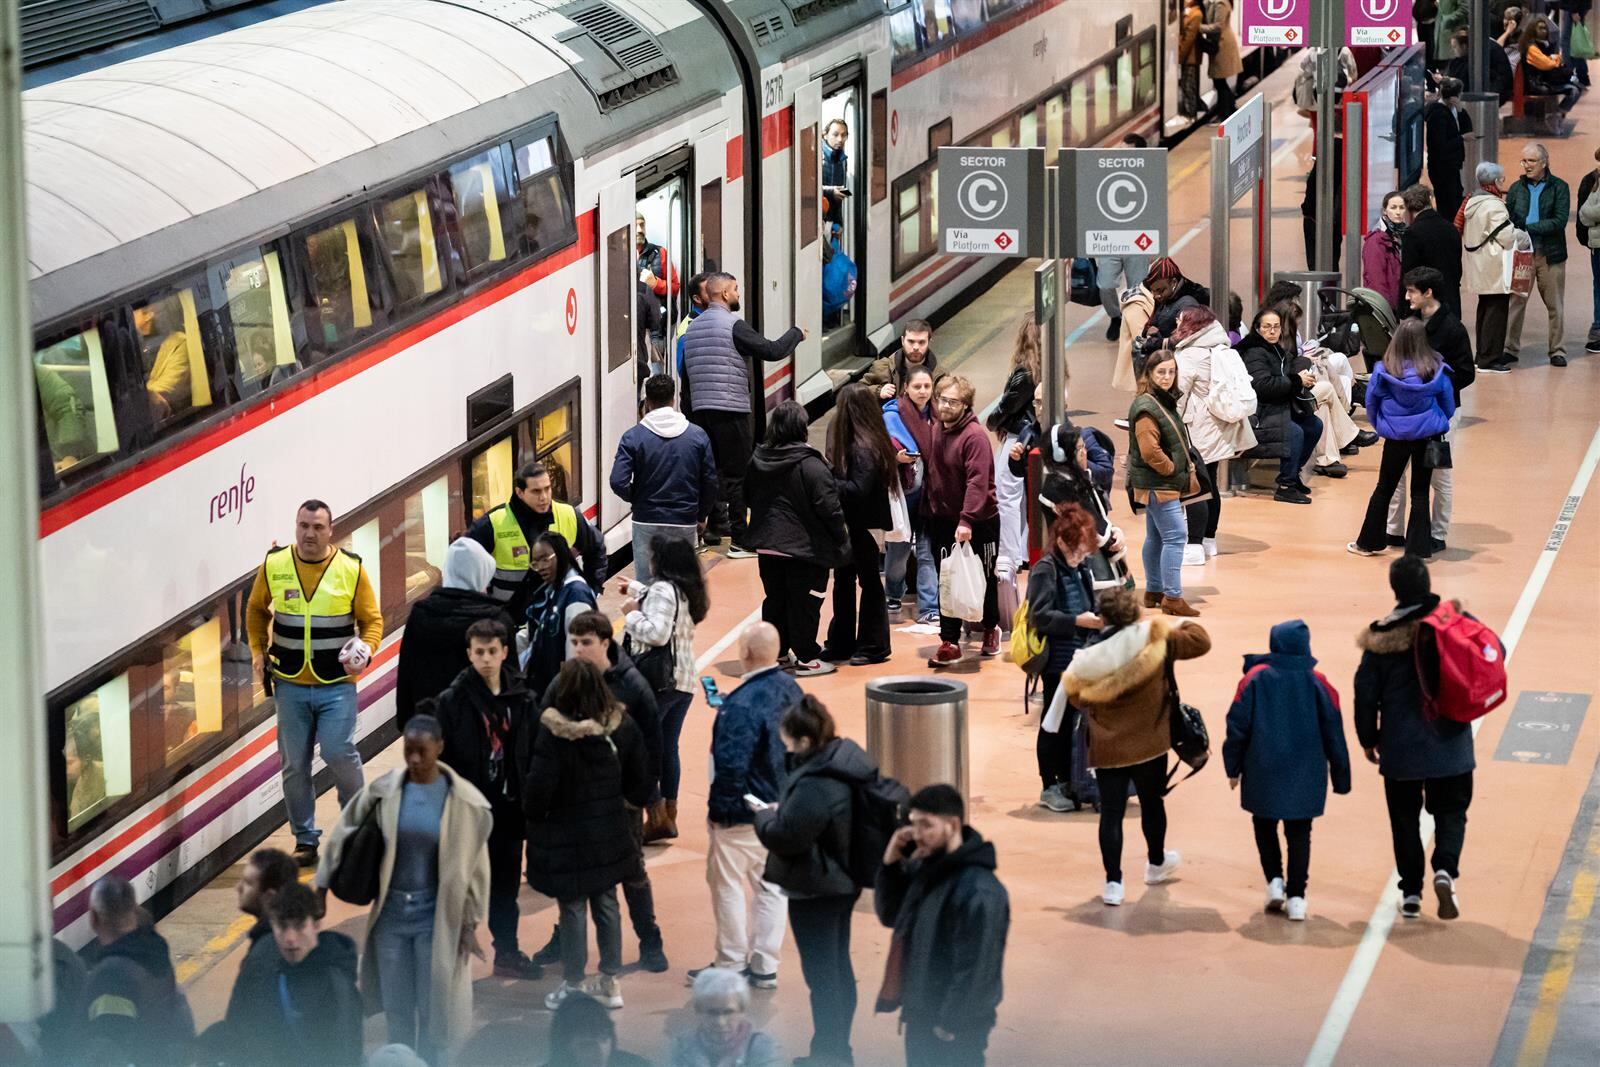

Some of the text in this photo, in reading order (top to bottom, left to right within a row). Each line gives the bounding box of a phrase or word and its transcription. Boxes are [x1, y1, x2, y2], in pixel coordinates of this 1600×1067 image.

[1253, 35, 1280, 43] Platform
[1288, 31, 1295, 39] 3
[1356, 36, 1384, 44] Platform
[1391, 32, 1398, 40] 4
[765, 74, 784, 108] 257R
[960, 156, 1006, 167] SECTOR
[1098, 158, 1144, 168] SECTOR
[968, 178, 997, 213] C
[1107, 179, 1137, 215] C
[953, 240, 990, 252] Platform
[999, 235, 1008, 247] 3
[1139, 236, 1148, 248] 4
[1093, 242, 1130, 254] Platform
[209, 461, 255, 525] renfe
